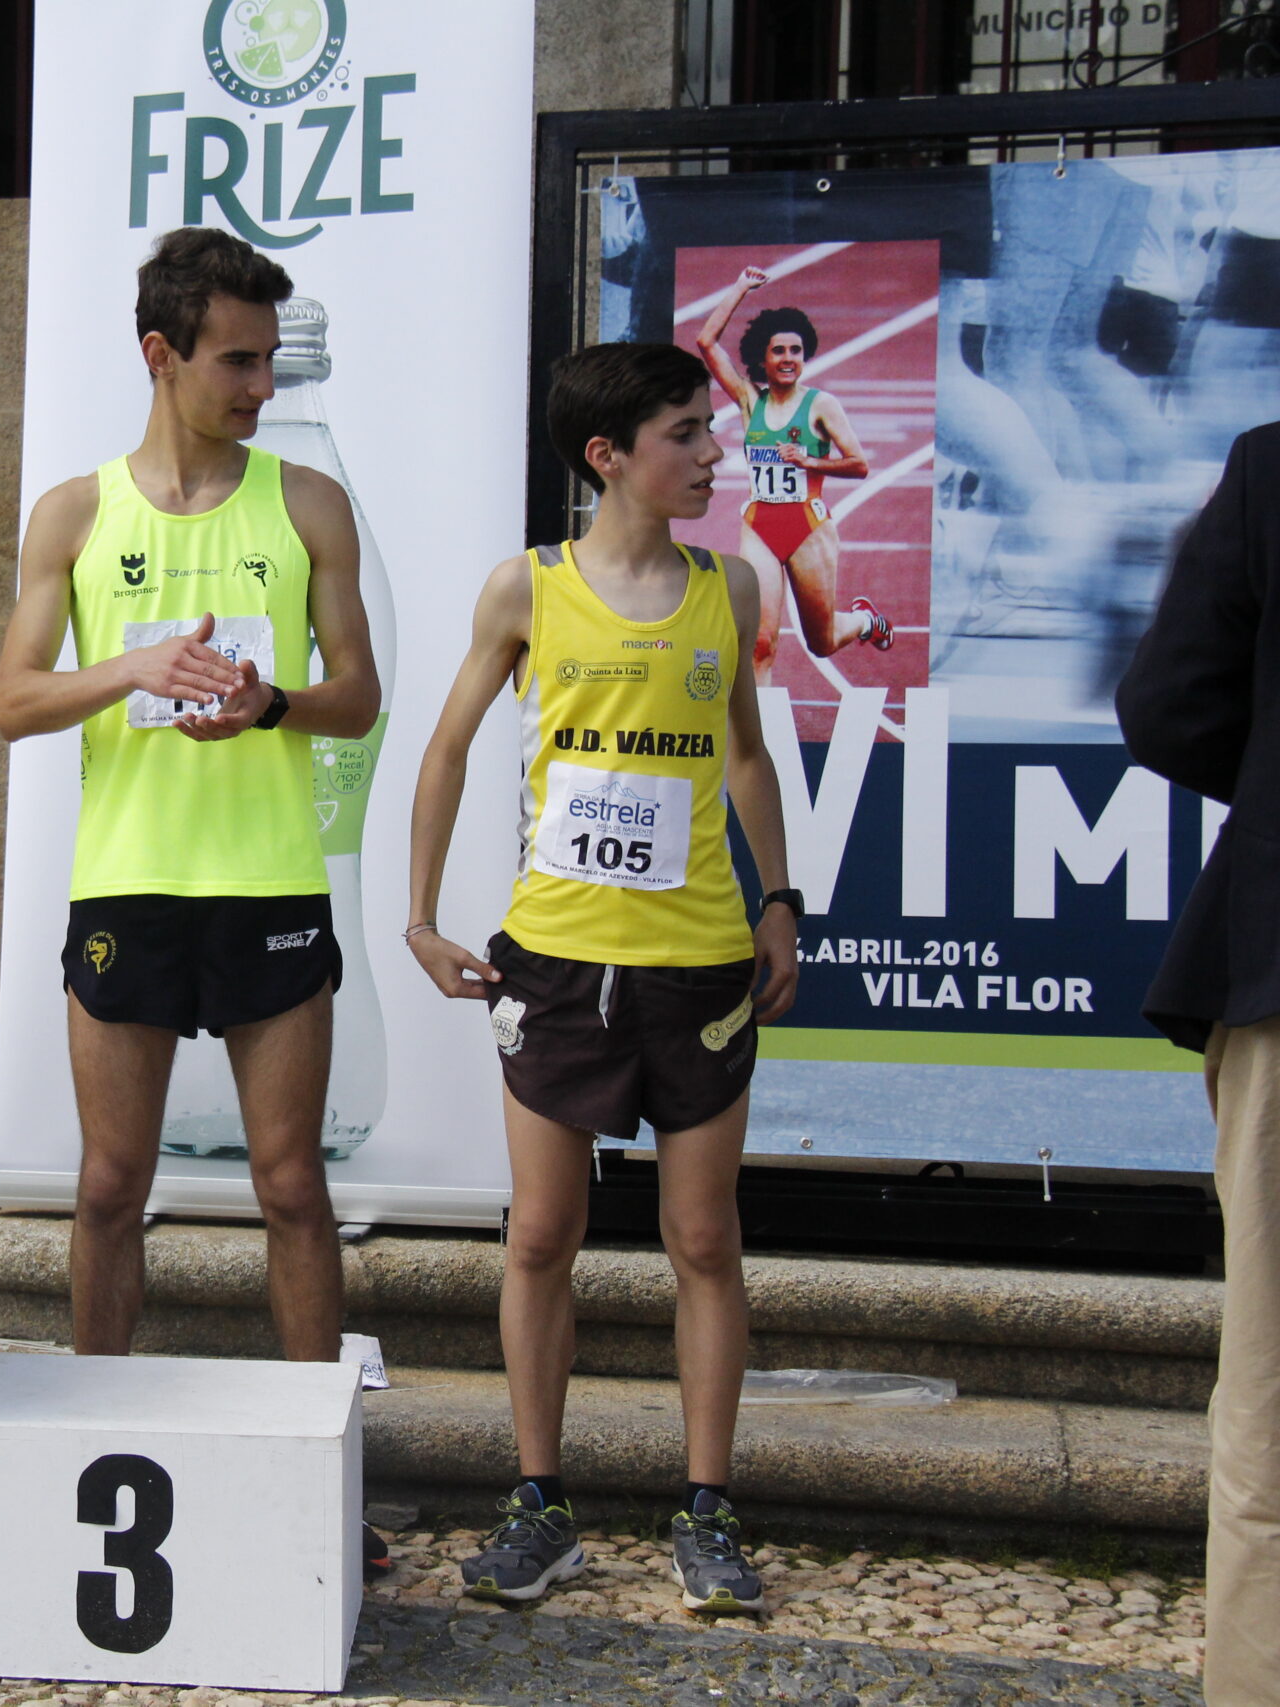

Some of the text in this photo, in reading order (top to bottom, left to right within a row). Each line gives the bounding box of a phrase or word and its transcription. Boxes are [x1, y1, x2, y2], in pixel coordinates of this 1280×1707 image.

[129, 73, 416, 249] FRIZE
[750, 448, 785, 463] SNICK
[752, 466, 797, 495] 715
[113, 587, 159, 599] Bragança
[622, 639, 673, 650] macron
[583, 668, 611, 677] Quinta
[613, 667, 623, 675] da
[625, 667, 642, 675] Lixa
[555, 728, 715, 758] U.D. VÁRZEA
[569, 798, 655, 827] estrela
[757, 687, 949, 917] VI
[571, 833, 653, 874] 105
[569, 867, 598, 875] MARCELO
[609, 873, 638, 881] AZEVEDO
[266, 931, 304, 942] SPORT
[267, 940, 306, 951] ZONE
[861, 972, 1094, 1013] VILA FLOR
[76, 1453, 174, 1654] 3
